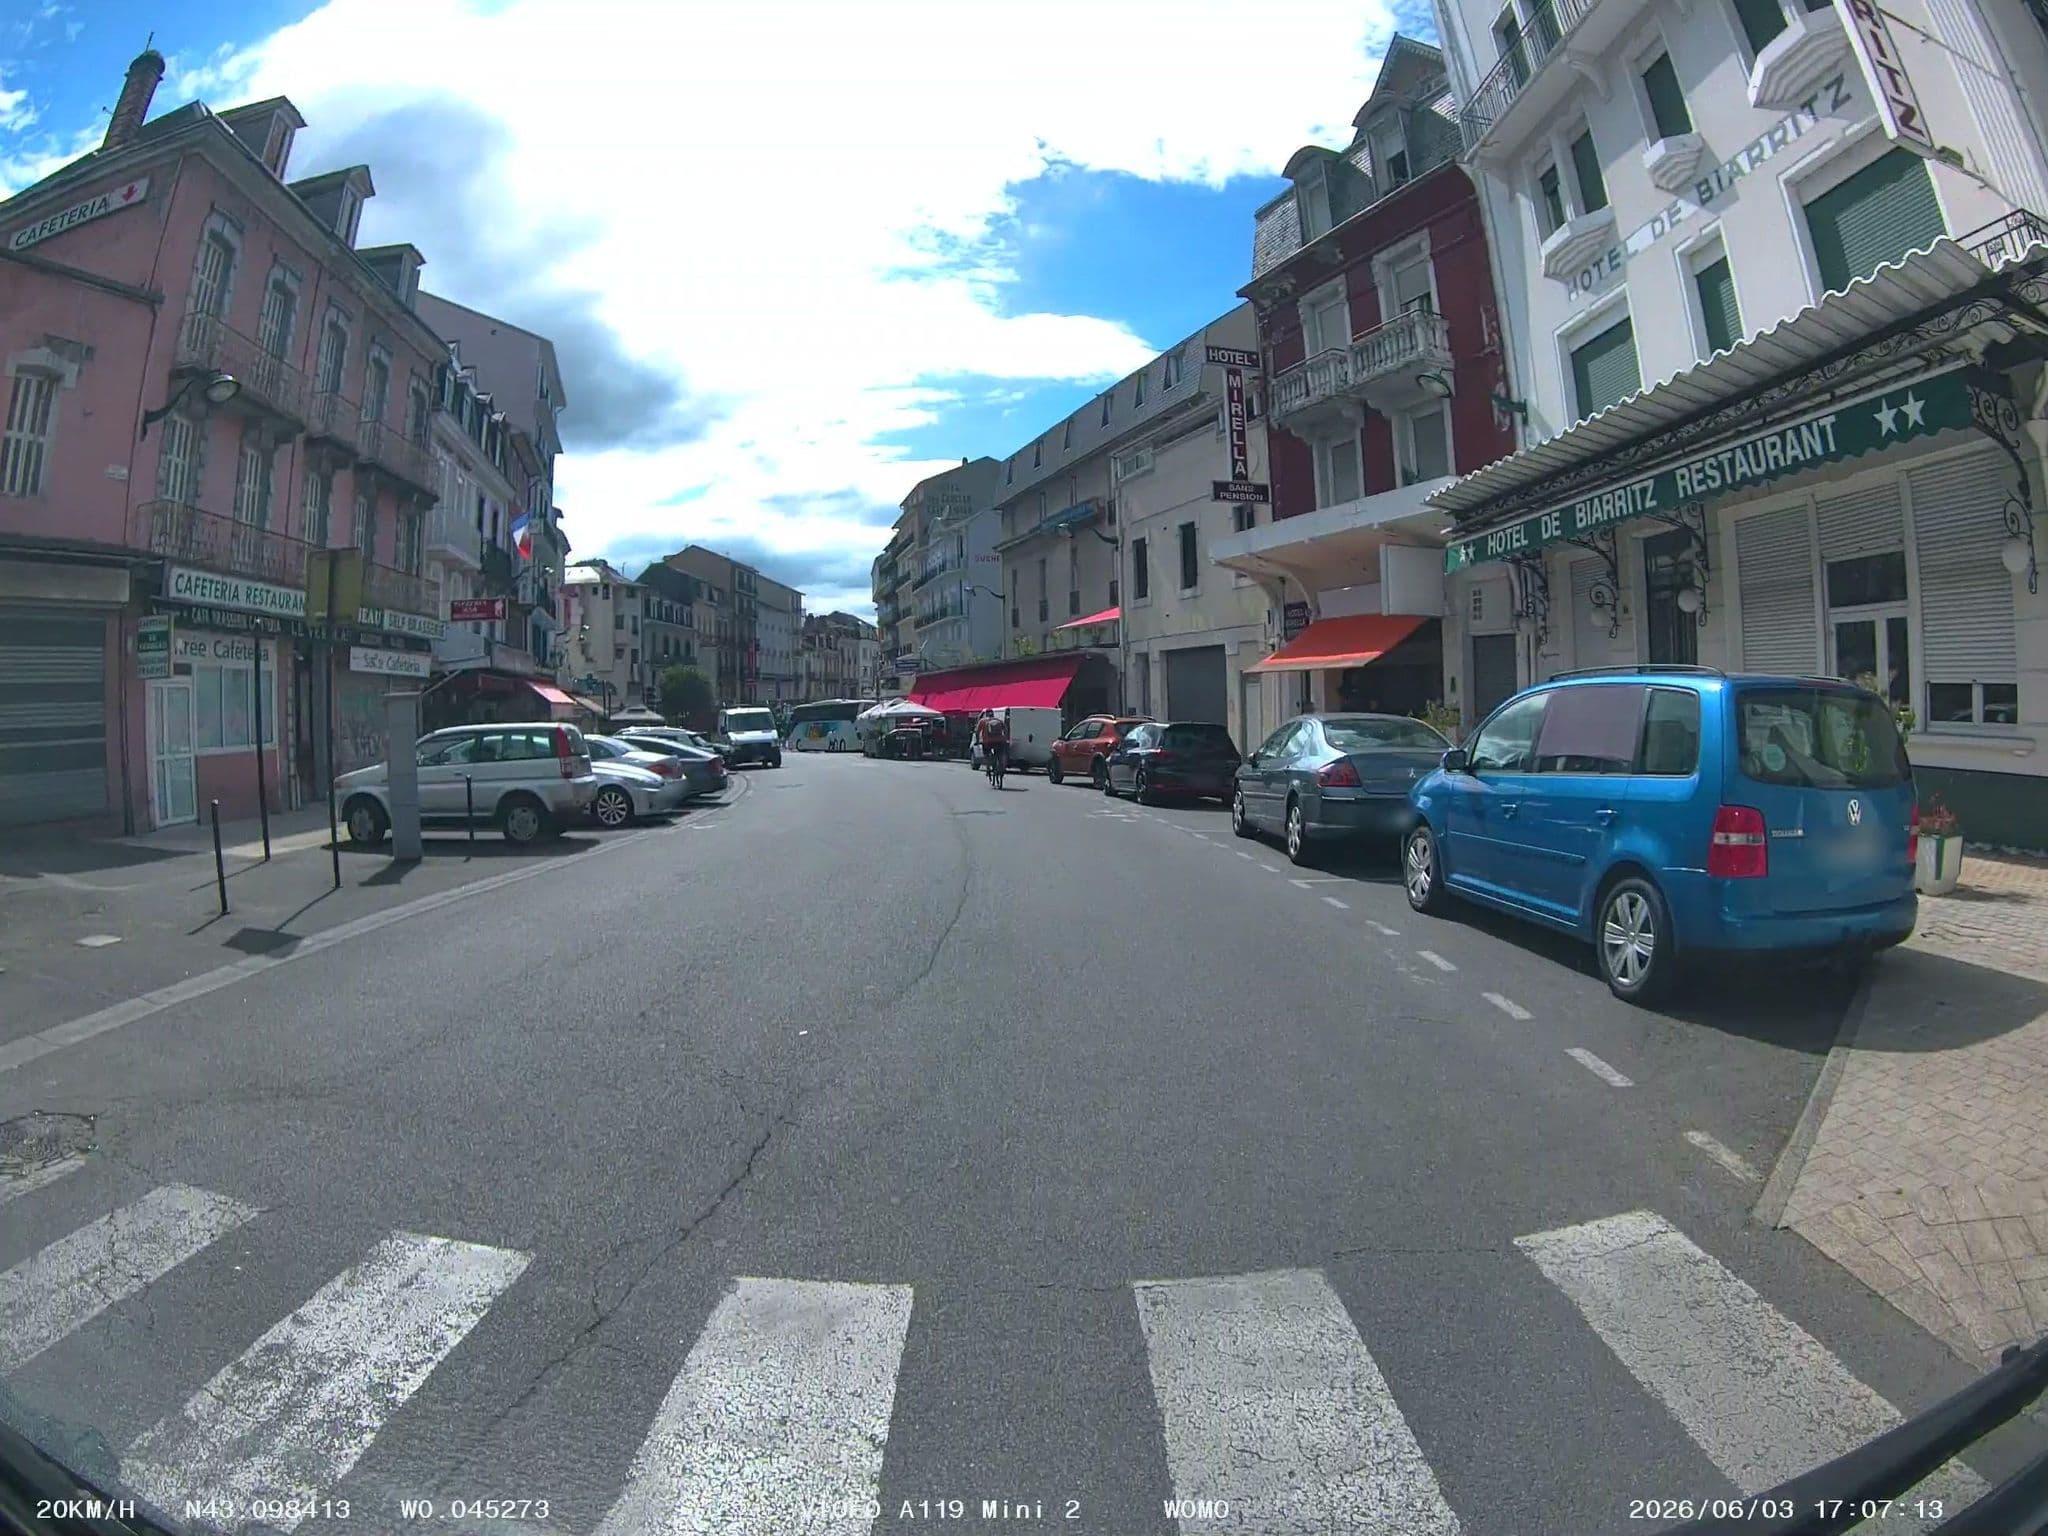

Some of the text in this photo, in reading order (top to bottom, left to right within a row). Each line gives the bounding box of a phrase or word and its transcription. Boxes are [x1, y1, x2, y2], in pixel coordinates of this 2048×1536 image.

[1568, 72, 1853, 301] HOTEL DE BIARRITZ
[15, 197, 109, 247] CAFETERIA
[1209, 349, 1252, 366] HOTEL
[1228, 374, 1247, 475] MIRELLA
[1219, 491, 1264, 502] PENSION
[1228, 483, 1255, 493] SANS
[1487, 414, 1837, 556] HOTEL DE BIARRITZ RESTAURANT
[175, 573, 305, 611] CAFETERIA RESTAURAN
